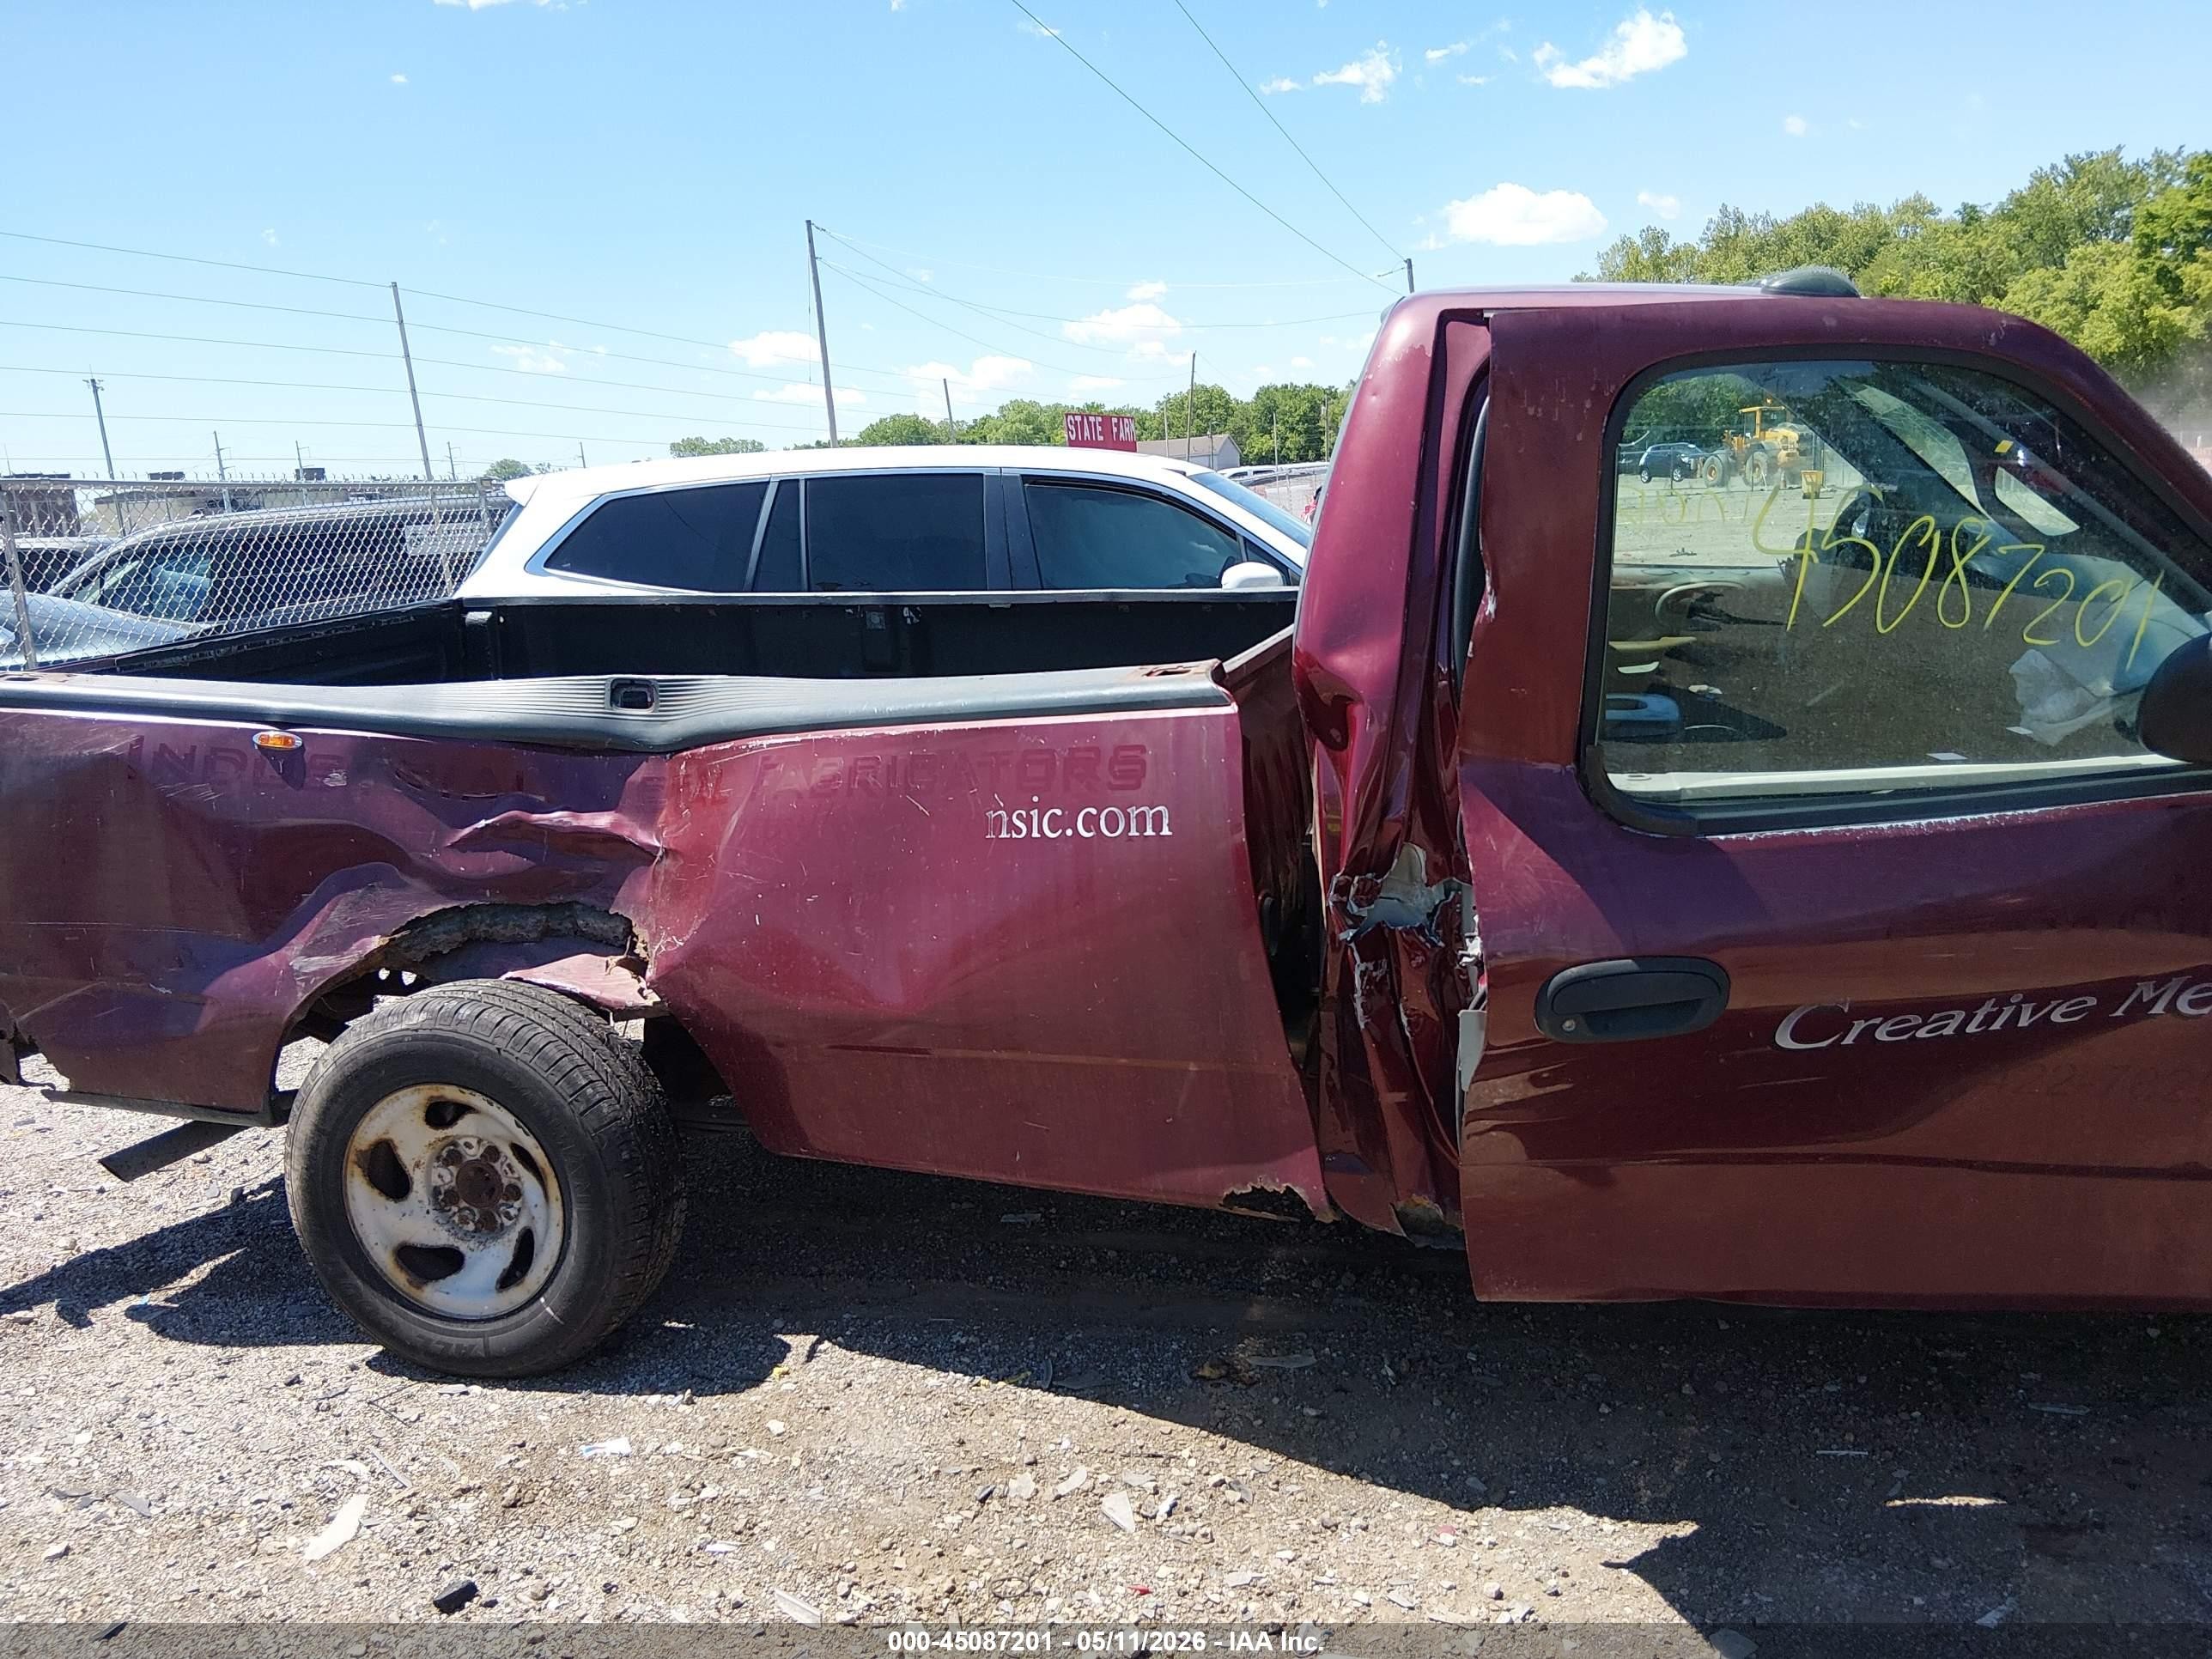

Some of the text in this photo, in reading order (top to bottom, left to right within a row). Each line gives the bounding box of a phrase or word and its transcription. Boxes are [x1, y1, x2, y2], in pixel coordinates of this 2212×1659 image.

[1067, 416, 1136, 441] STATE FARM
[1753, 483, 2165, 672] 45087201
[985, 794, 1173, 839] nsic.com
[1773, 975, 2212, 1051] Creative Me
